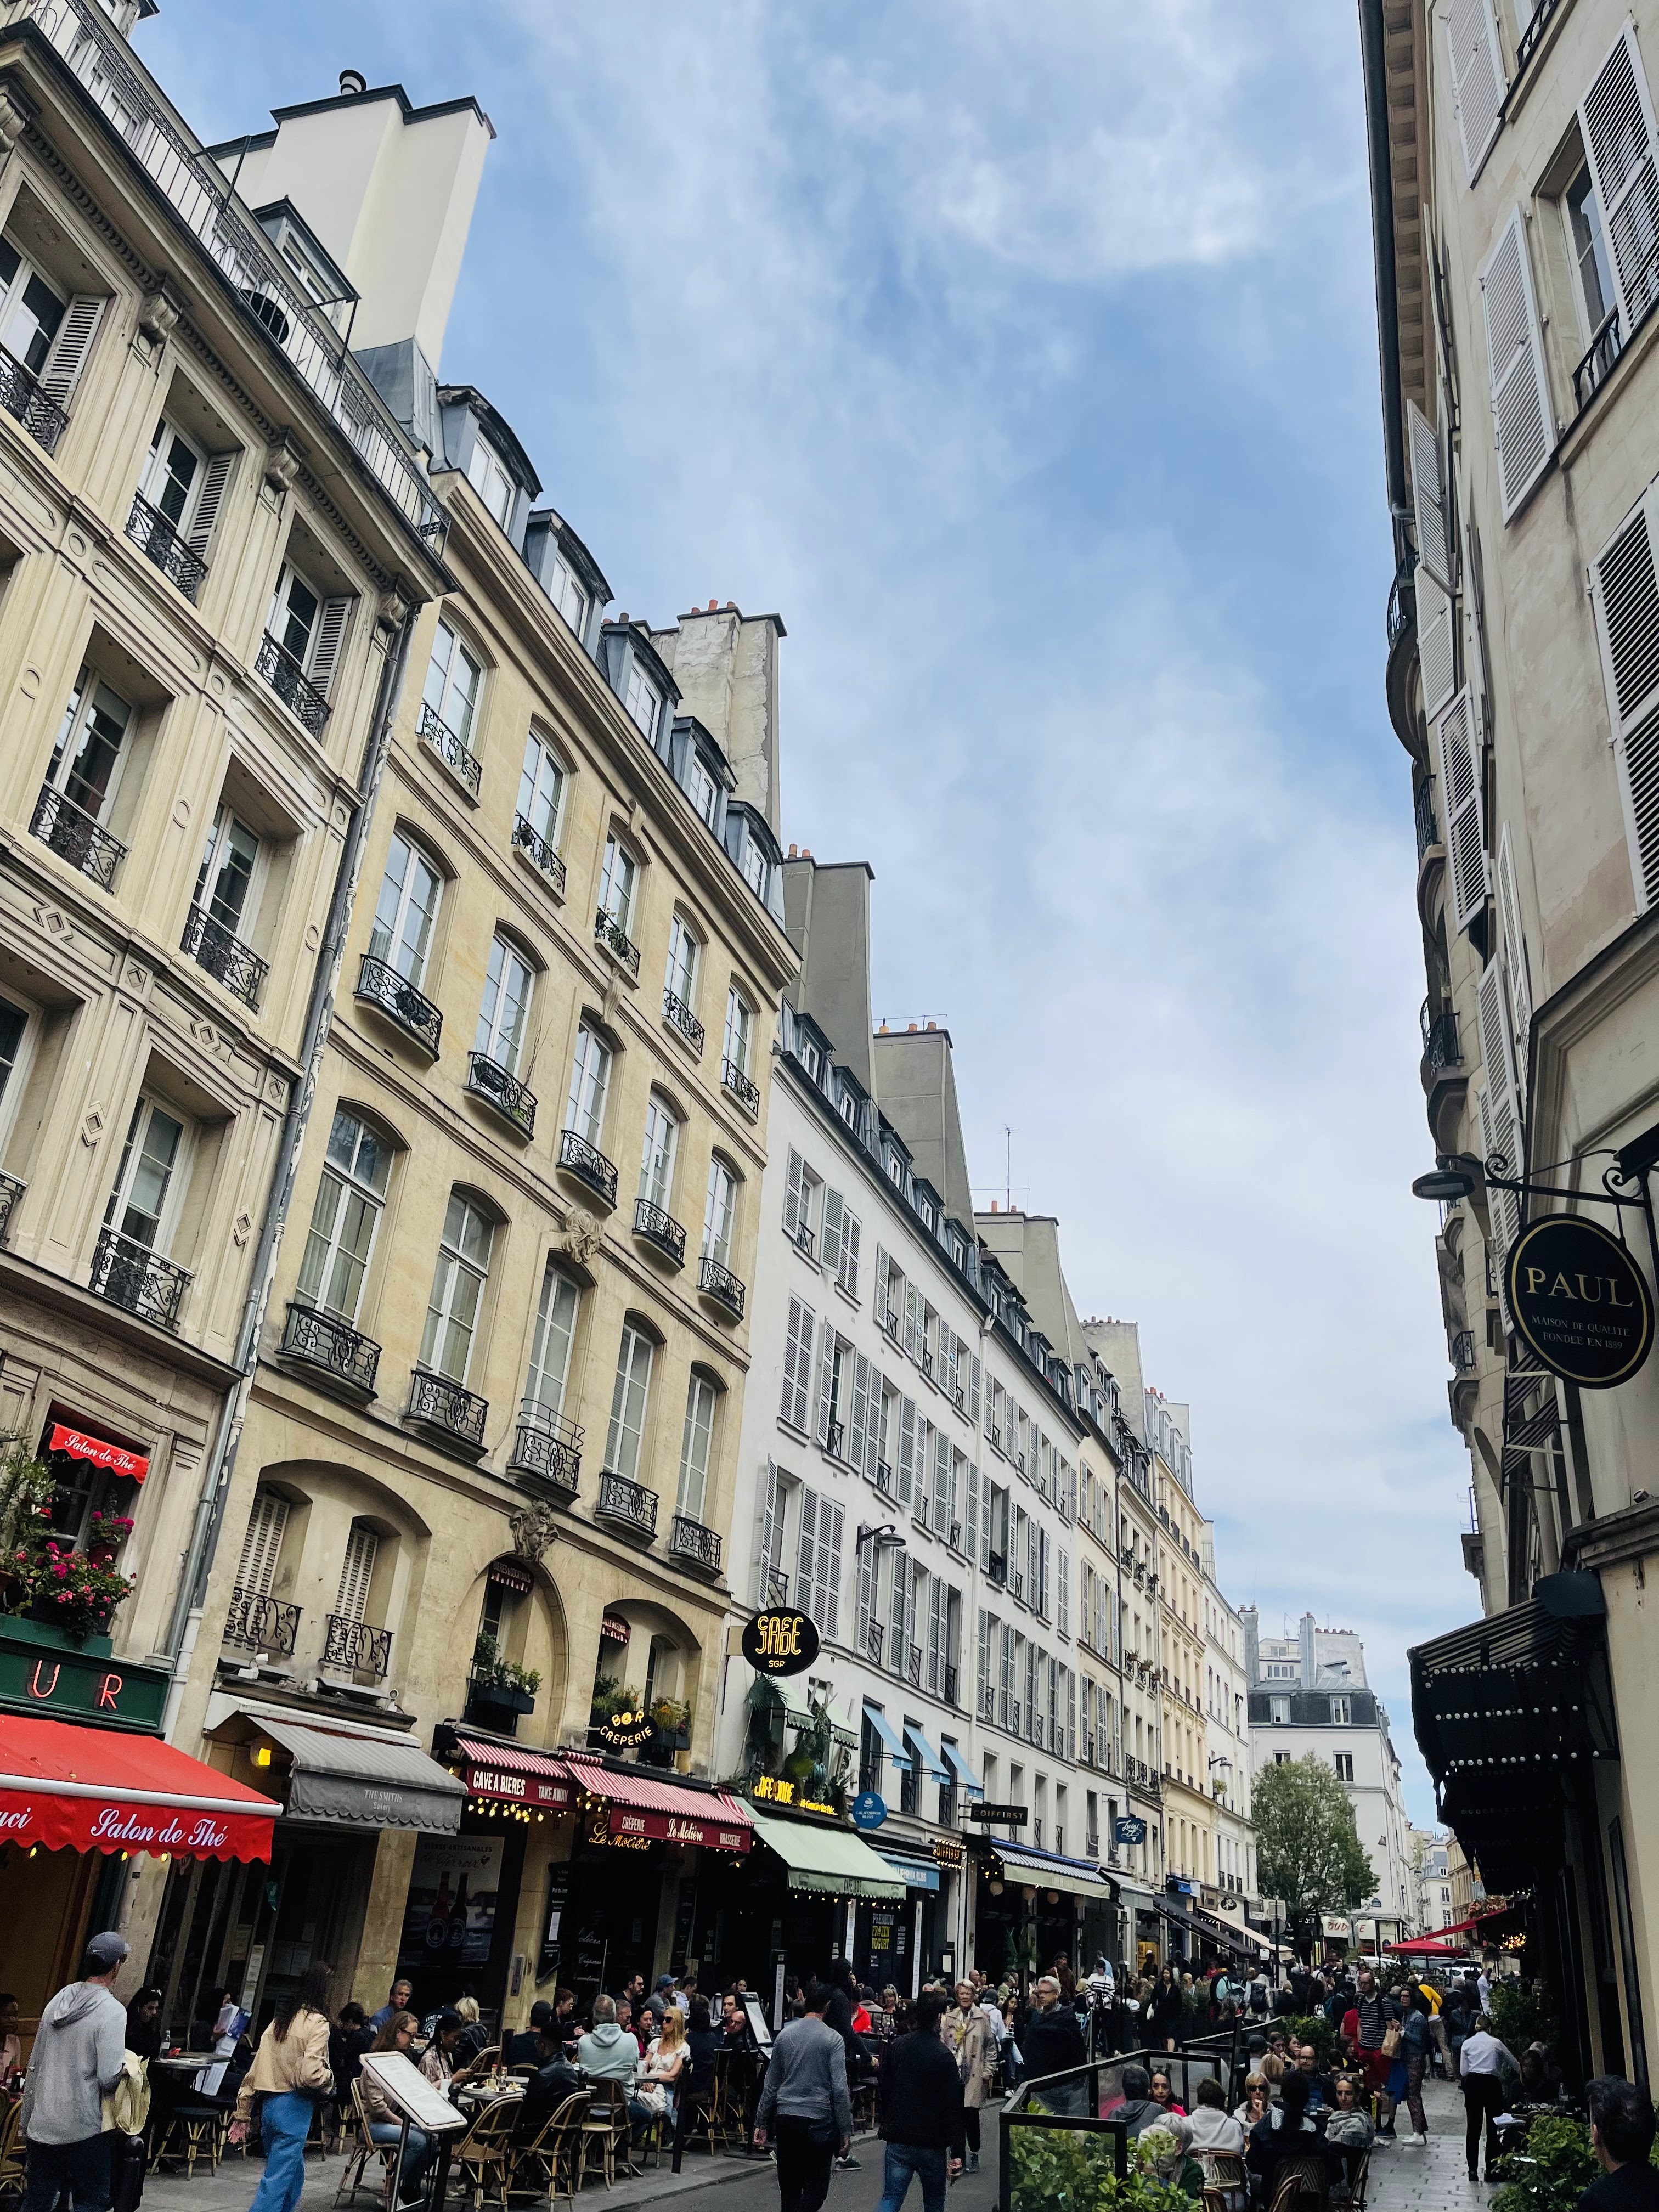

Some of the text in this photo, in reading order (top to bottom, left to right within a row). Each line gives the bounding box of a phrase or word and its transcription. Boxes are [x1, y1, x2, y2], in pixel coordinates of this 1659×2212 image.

[1525, 1267, 1634, 1307] PAUL
[1531, 1315, 1568, 1328] MAISON
[1572, 1322, 1584, 1330] DE
[1587, 1338, 1602, 1347] EN
[1605, 1340, 1623, 1350] 1889
[64, 1434, 136, 1471] Salon de Thé
[600, 1726, 653, 1746] CREPERIE
[473, 1770, 526, 1796] CAVE A BIERES
[364, 1789, 403, 1803] THE SMITHS
[538, 1785, 569, 1803] TAKE AWAY
[373, 1801, 391, 1812] Bakery
[973, 1809, 1024, 1820] COIFFIRST
[90, 1808, 229, 1847] Salon de Thé
[589, 1822, 607, 1844] Le
[622, 1815, 741, 1847] CRÊPERIE Le Molière BRASSERIE
[1117, 1819, 1142, 1837] Luigi
[449, 1844, 493, 1853] ARTISANALES
